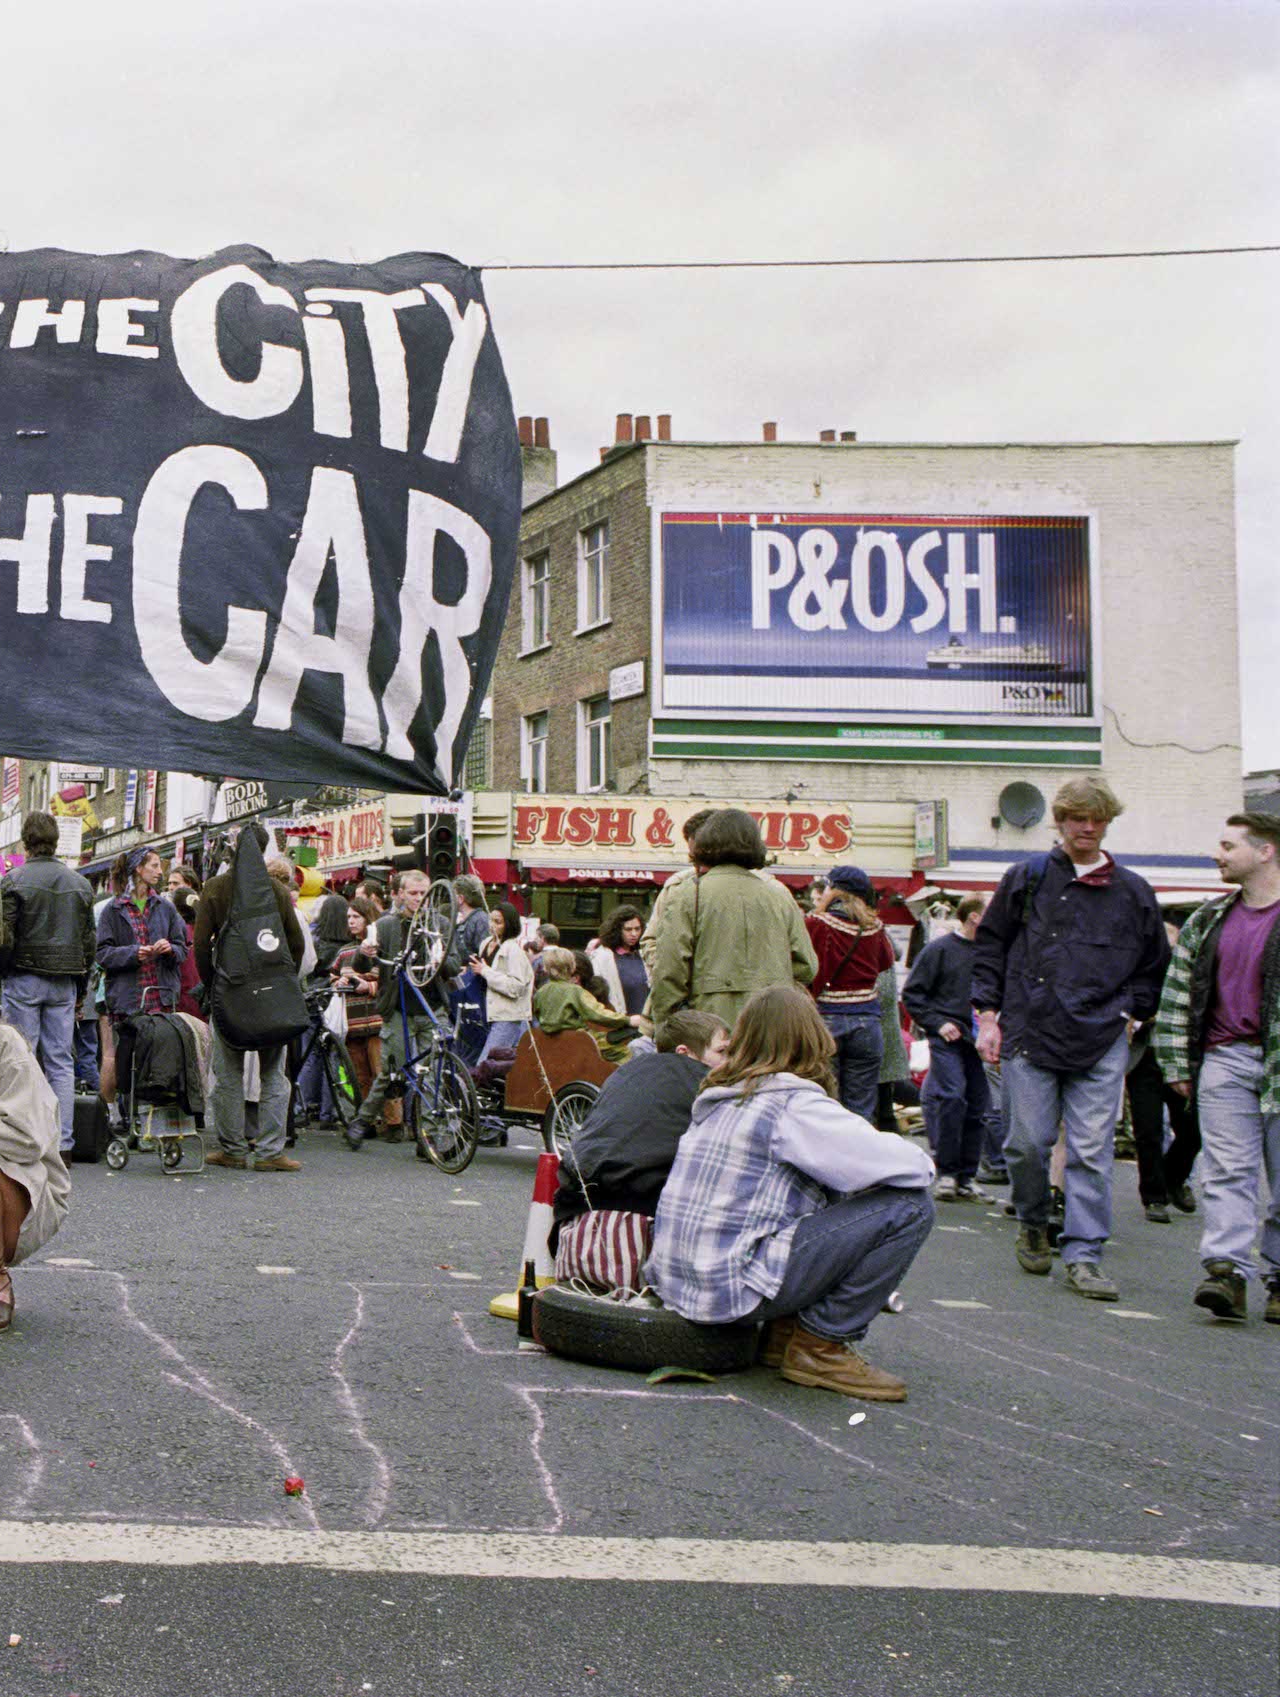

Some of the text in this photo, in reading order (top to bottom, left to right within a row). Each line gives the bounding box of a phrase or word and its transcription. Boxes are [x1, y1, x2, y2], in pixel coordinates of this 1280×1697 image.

[750, 527, 1017, 633] P&OSH.
[132, 444, 492, 790] CAR
[1001, 685, 1040, 699] P&O
[225, 781, 265, 805] BODY
[227, 792, 268, 821] PIERCING
[349, 809, 384, 852] CHIPS
[514, 806, 637, 846] FISH
[645, 806, 674, 847] &
[568, 868, 654, 880] DONER KEBAB
